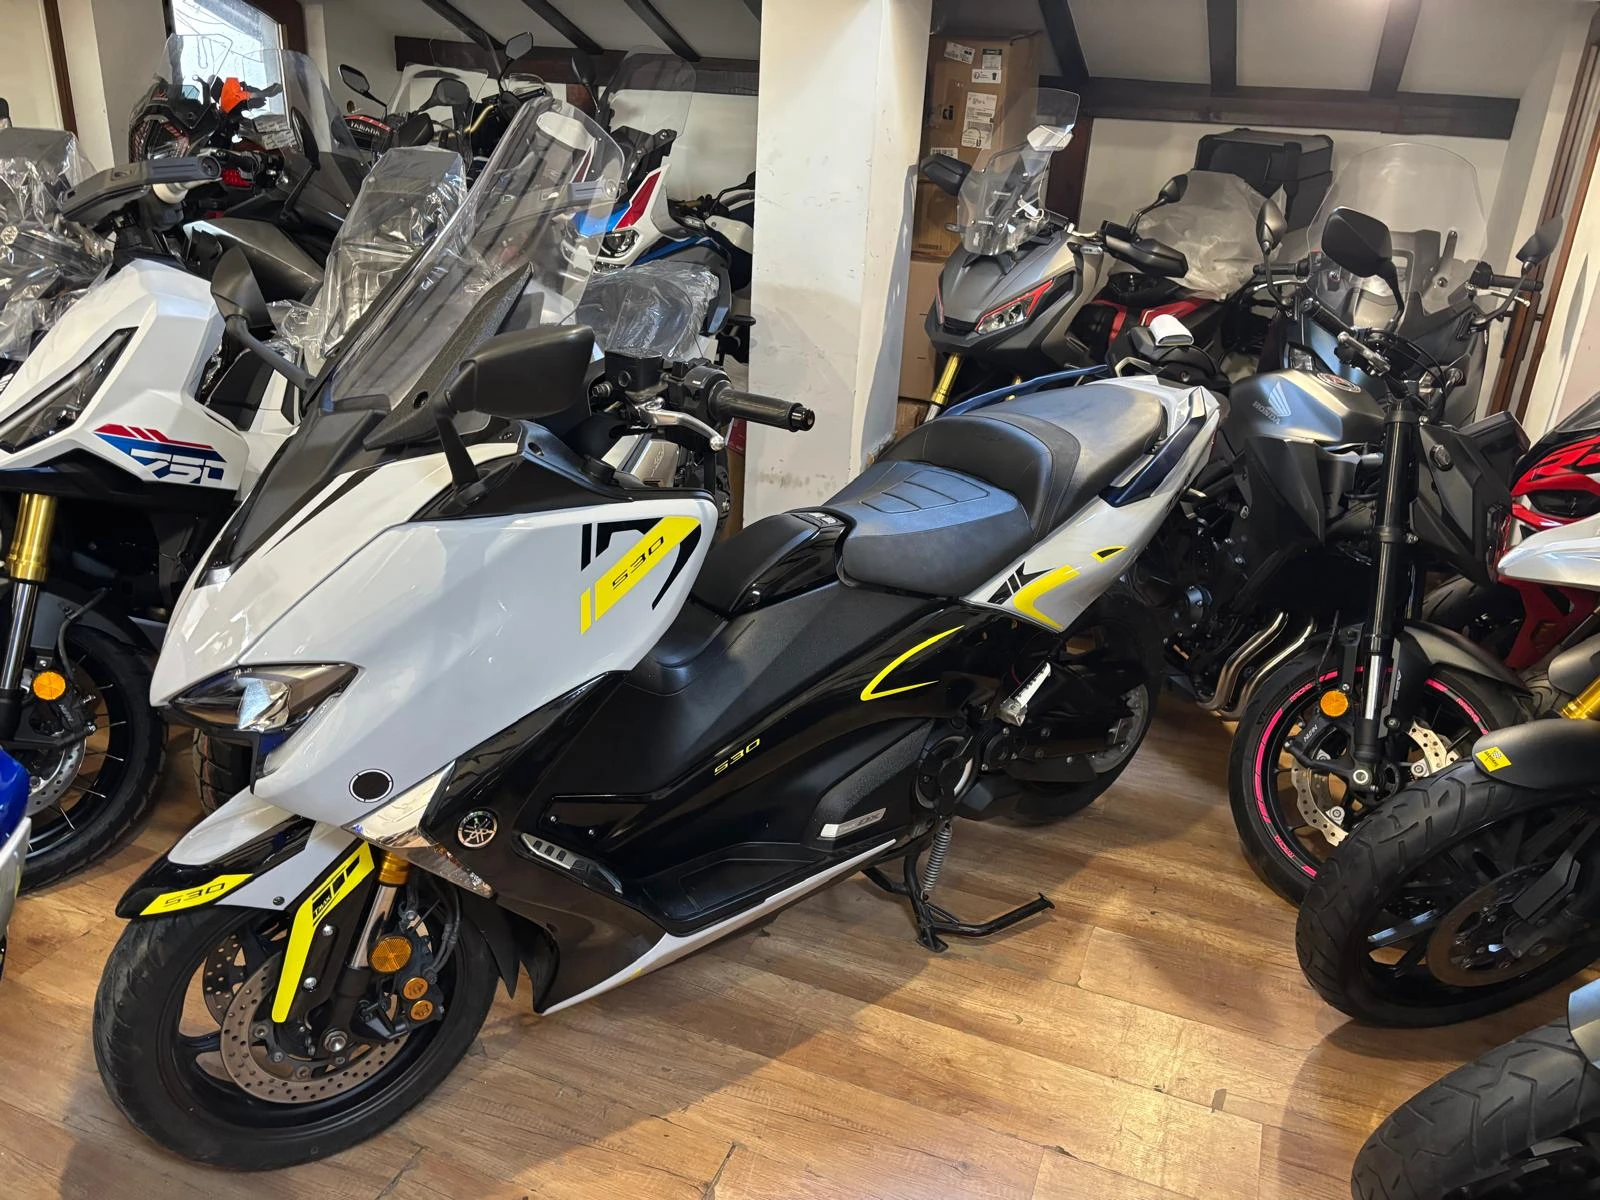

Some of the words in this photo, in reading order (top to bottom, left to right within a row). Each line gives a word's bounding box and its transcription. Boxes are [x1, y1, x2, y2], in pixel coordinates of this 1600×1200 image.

[1251, 400, 1281, 425] HONDA
[129, 448, 227, 488] 750
[612, 536, 664, 590] 530
[714, 738, 760, 776] 530
[163, 882, 226, 908] 530
